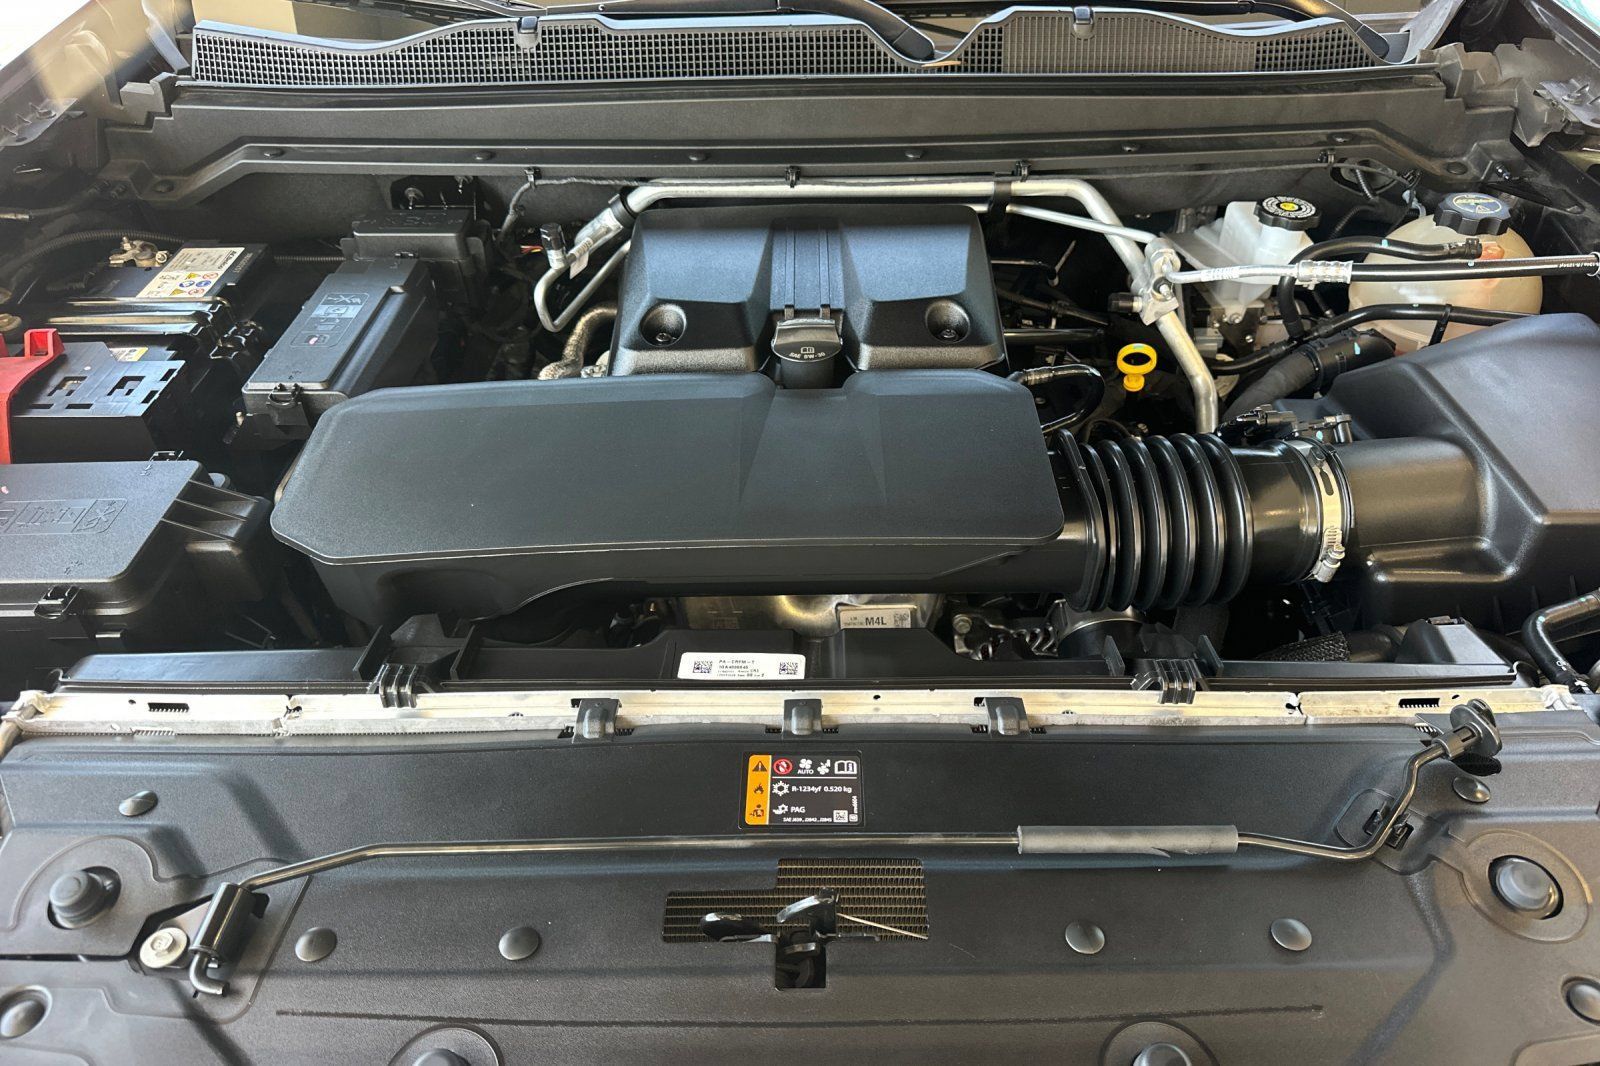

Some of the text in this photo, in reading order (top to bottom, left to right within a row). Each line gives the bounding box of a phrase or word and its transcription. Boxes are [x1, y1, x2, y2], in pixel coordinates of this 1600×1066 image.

[865, 616, 887, 626] M4L
[791, 785, 821, 793] R-1234yf
[843, 785, 852, 793] kg
